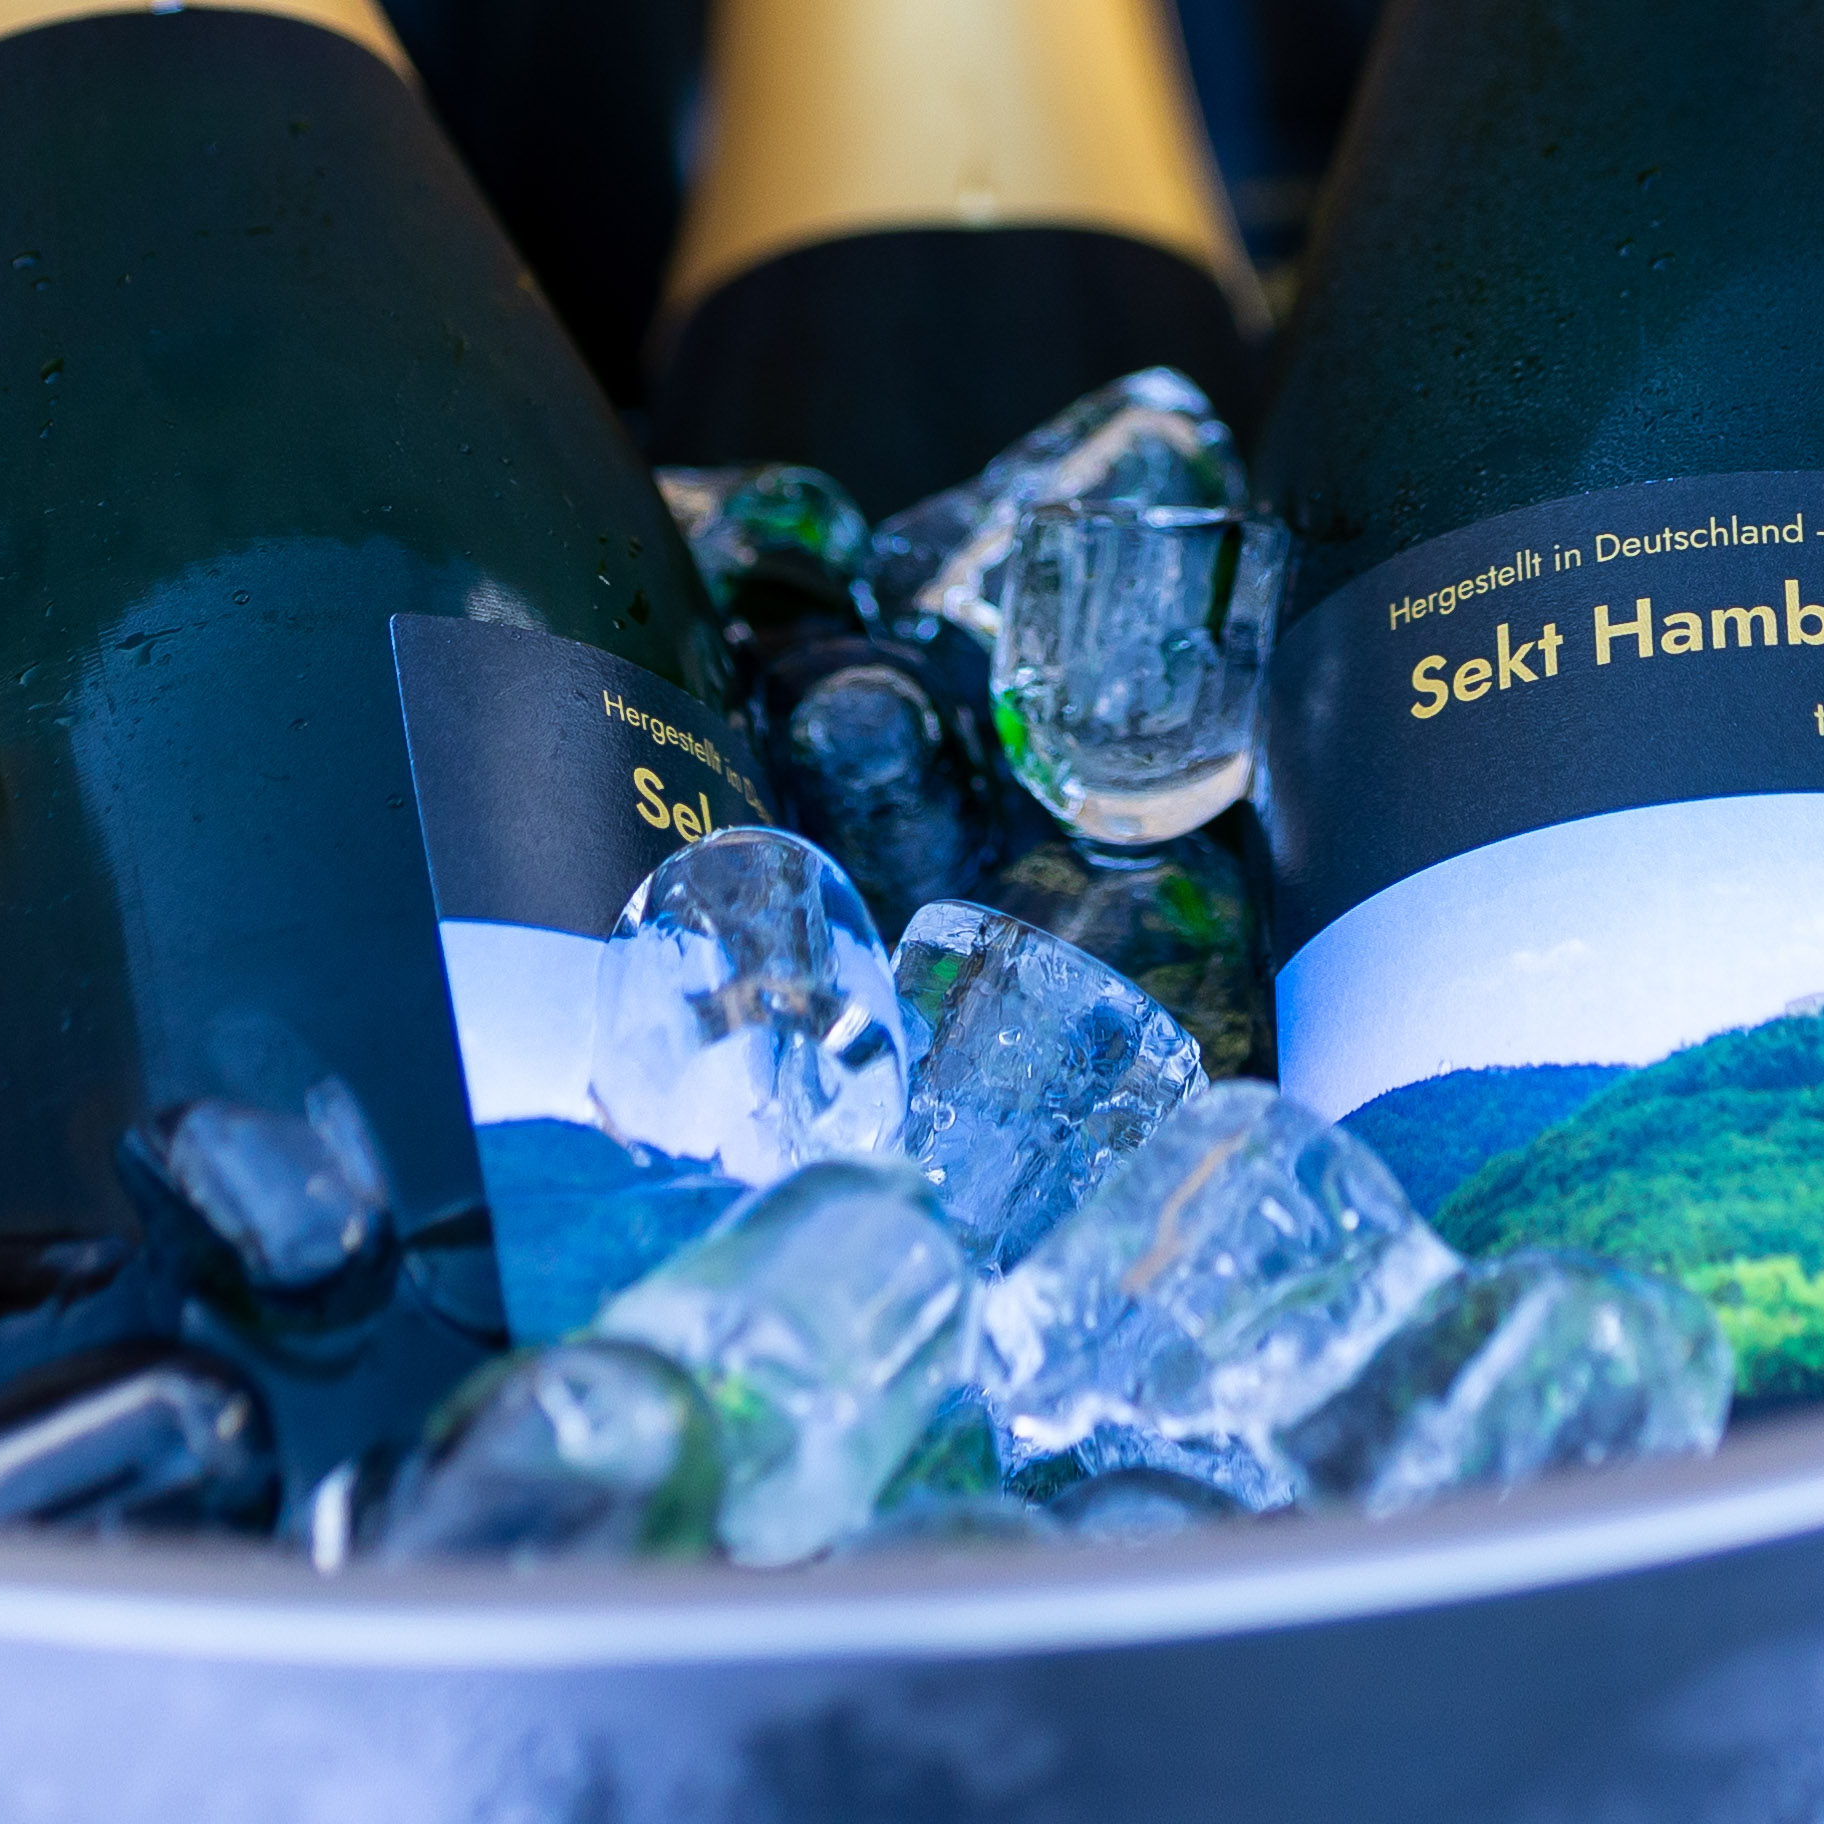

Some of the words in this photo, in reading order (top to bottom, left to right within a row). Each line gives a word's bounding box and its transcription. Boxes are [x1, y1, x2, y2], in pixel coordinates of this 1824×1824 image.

[1389, 550, 1542, 630] Hergestellt
[1554, 545, 1581, 572] in
[1595, 514, 1803, 563] Deutschland
[1410, 623, 1564, 720] Sekt
[603, 689, 722, 775] Hergestellt
